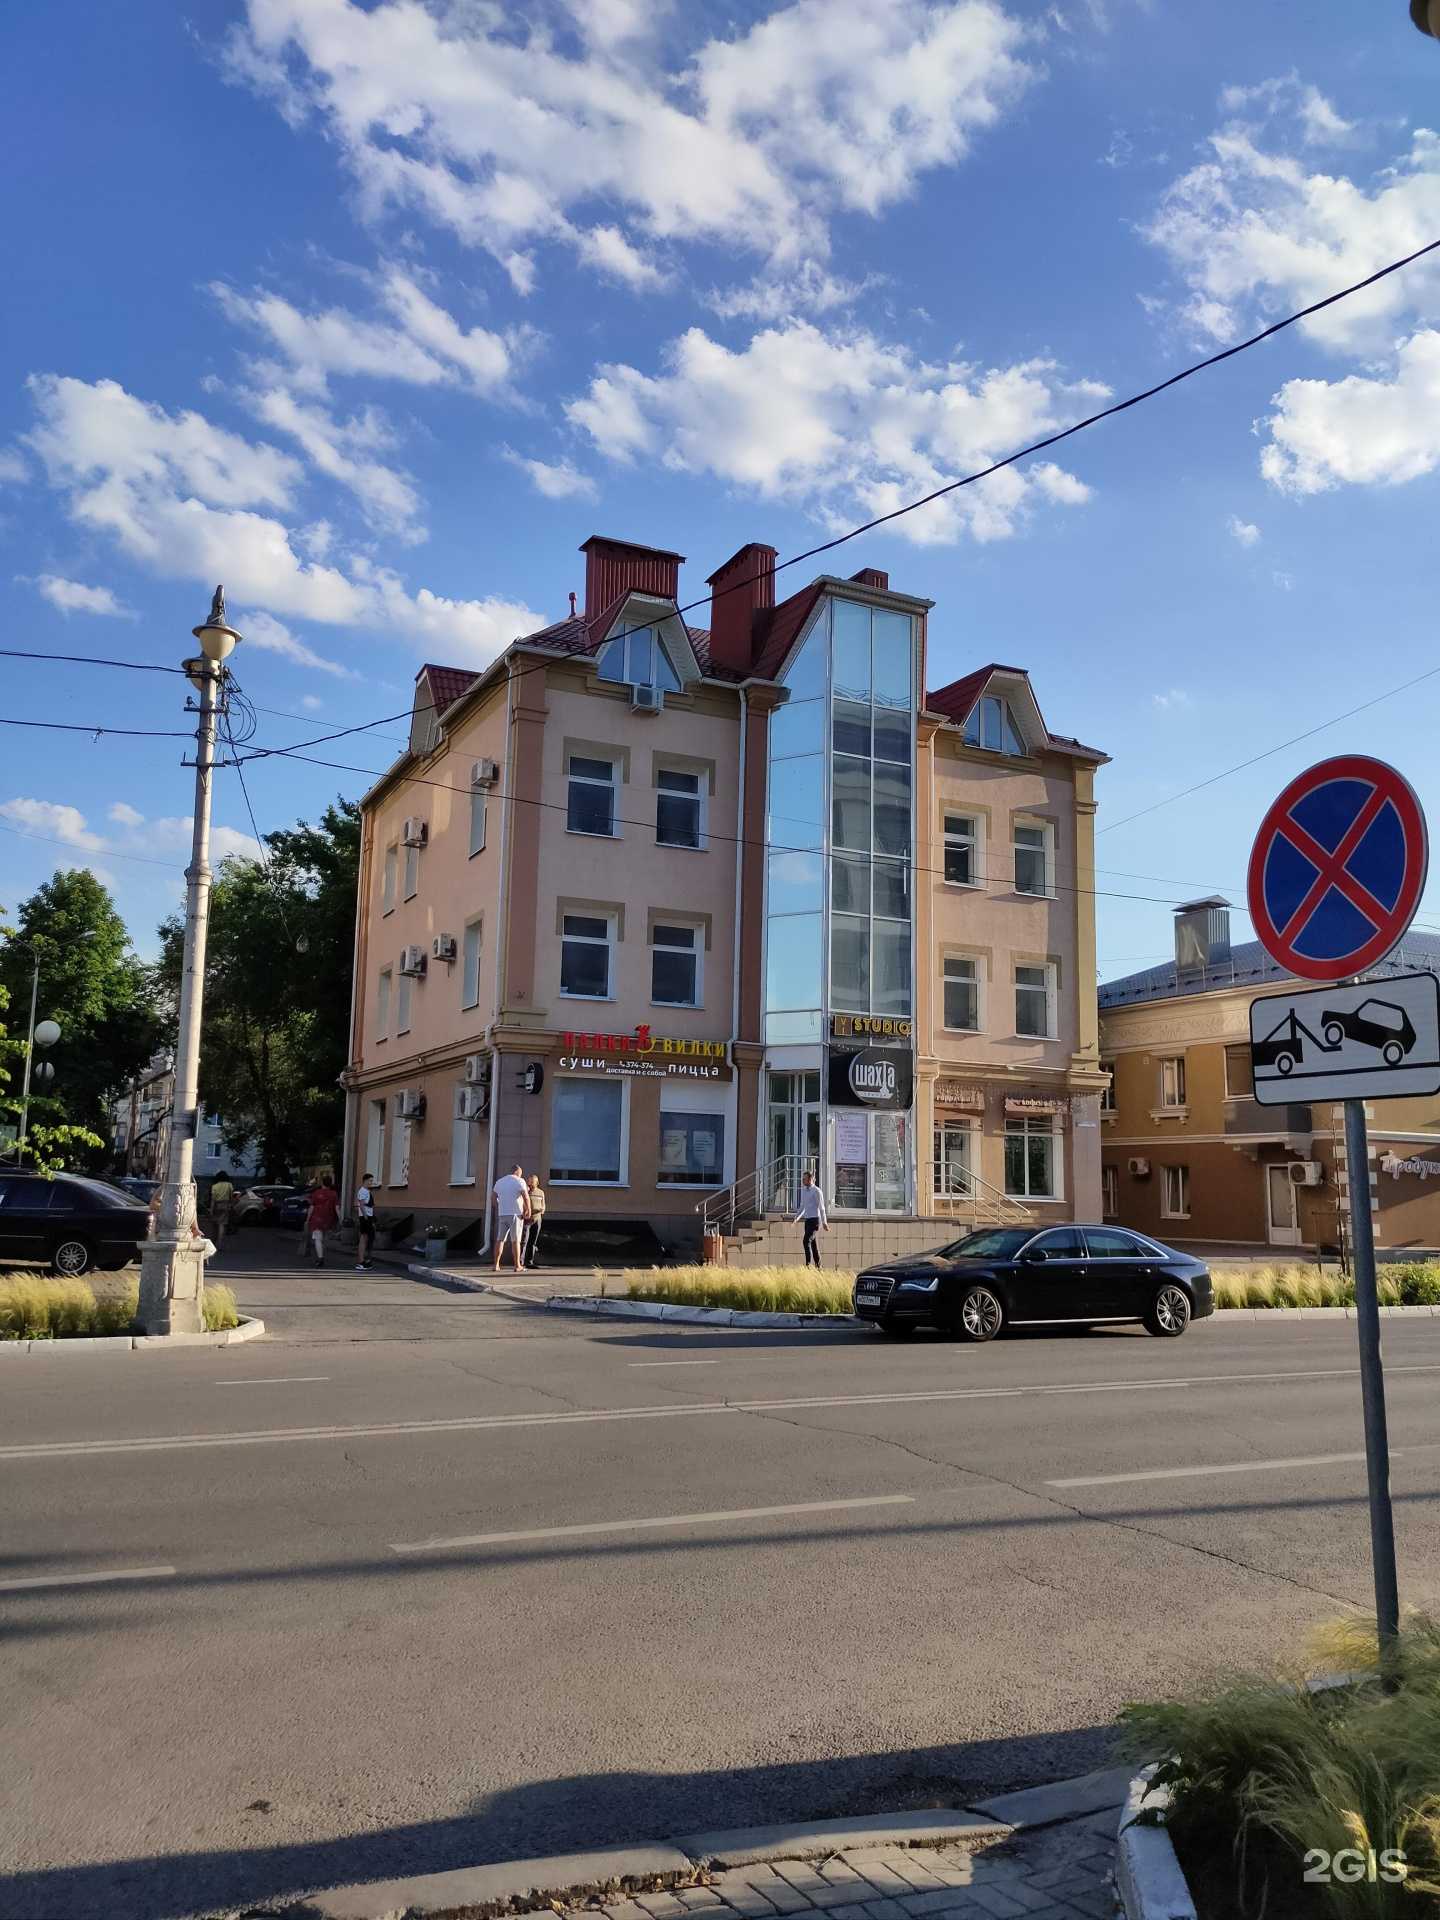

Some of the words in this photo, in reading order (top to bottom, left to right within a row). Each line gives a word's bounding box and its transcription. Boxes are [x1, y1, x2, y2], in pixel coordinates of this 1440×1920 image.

[854, 1017, 911, 1035] STUDIO
[663, 1038, 725, 1056] ВИЛКИ
[559, 1056, 606, 1070] суши
[668, 1063, 719, 1077] пицца
[647, 1069, 667, 1077] собой
